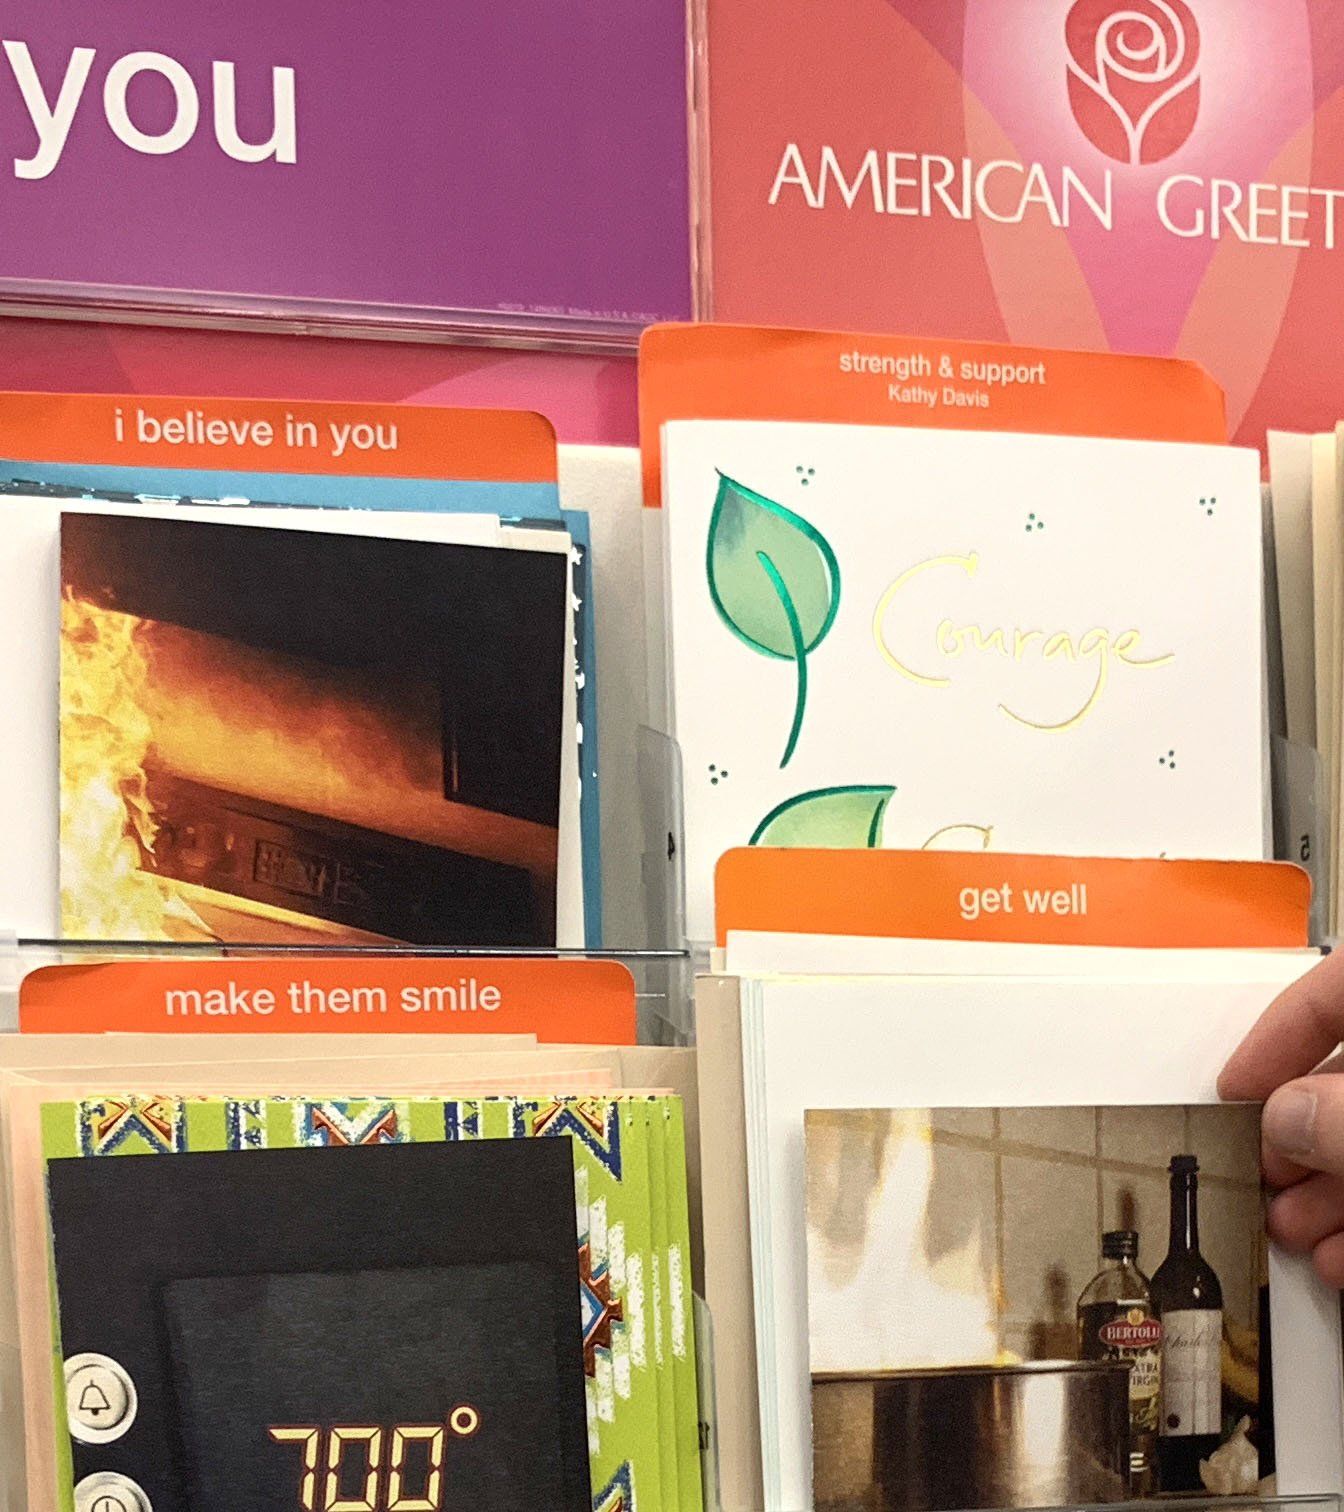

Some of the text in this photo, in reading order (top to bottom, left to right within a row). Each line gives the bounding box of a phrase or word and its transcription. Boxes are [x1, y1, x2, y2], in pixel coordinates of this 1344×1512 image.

[2, 40, 296, 179] you
[769, 143, 1112, 230] AMERICAN
[840, 351, 1046, 387] strength & support
[889, 384, 989, 407] Kathy Davis
[116, 409, 397, 456] i believe in you
[872, 550, 1176, 735] Courage
[960, 883, 1086, 920] get well
[166, 979, 500, 1015] make them smile
